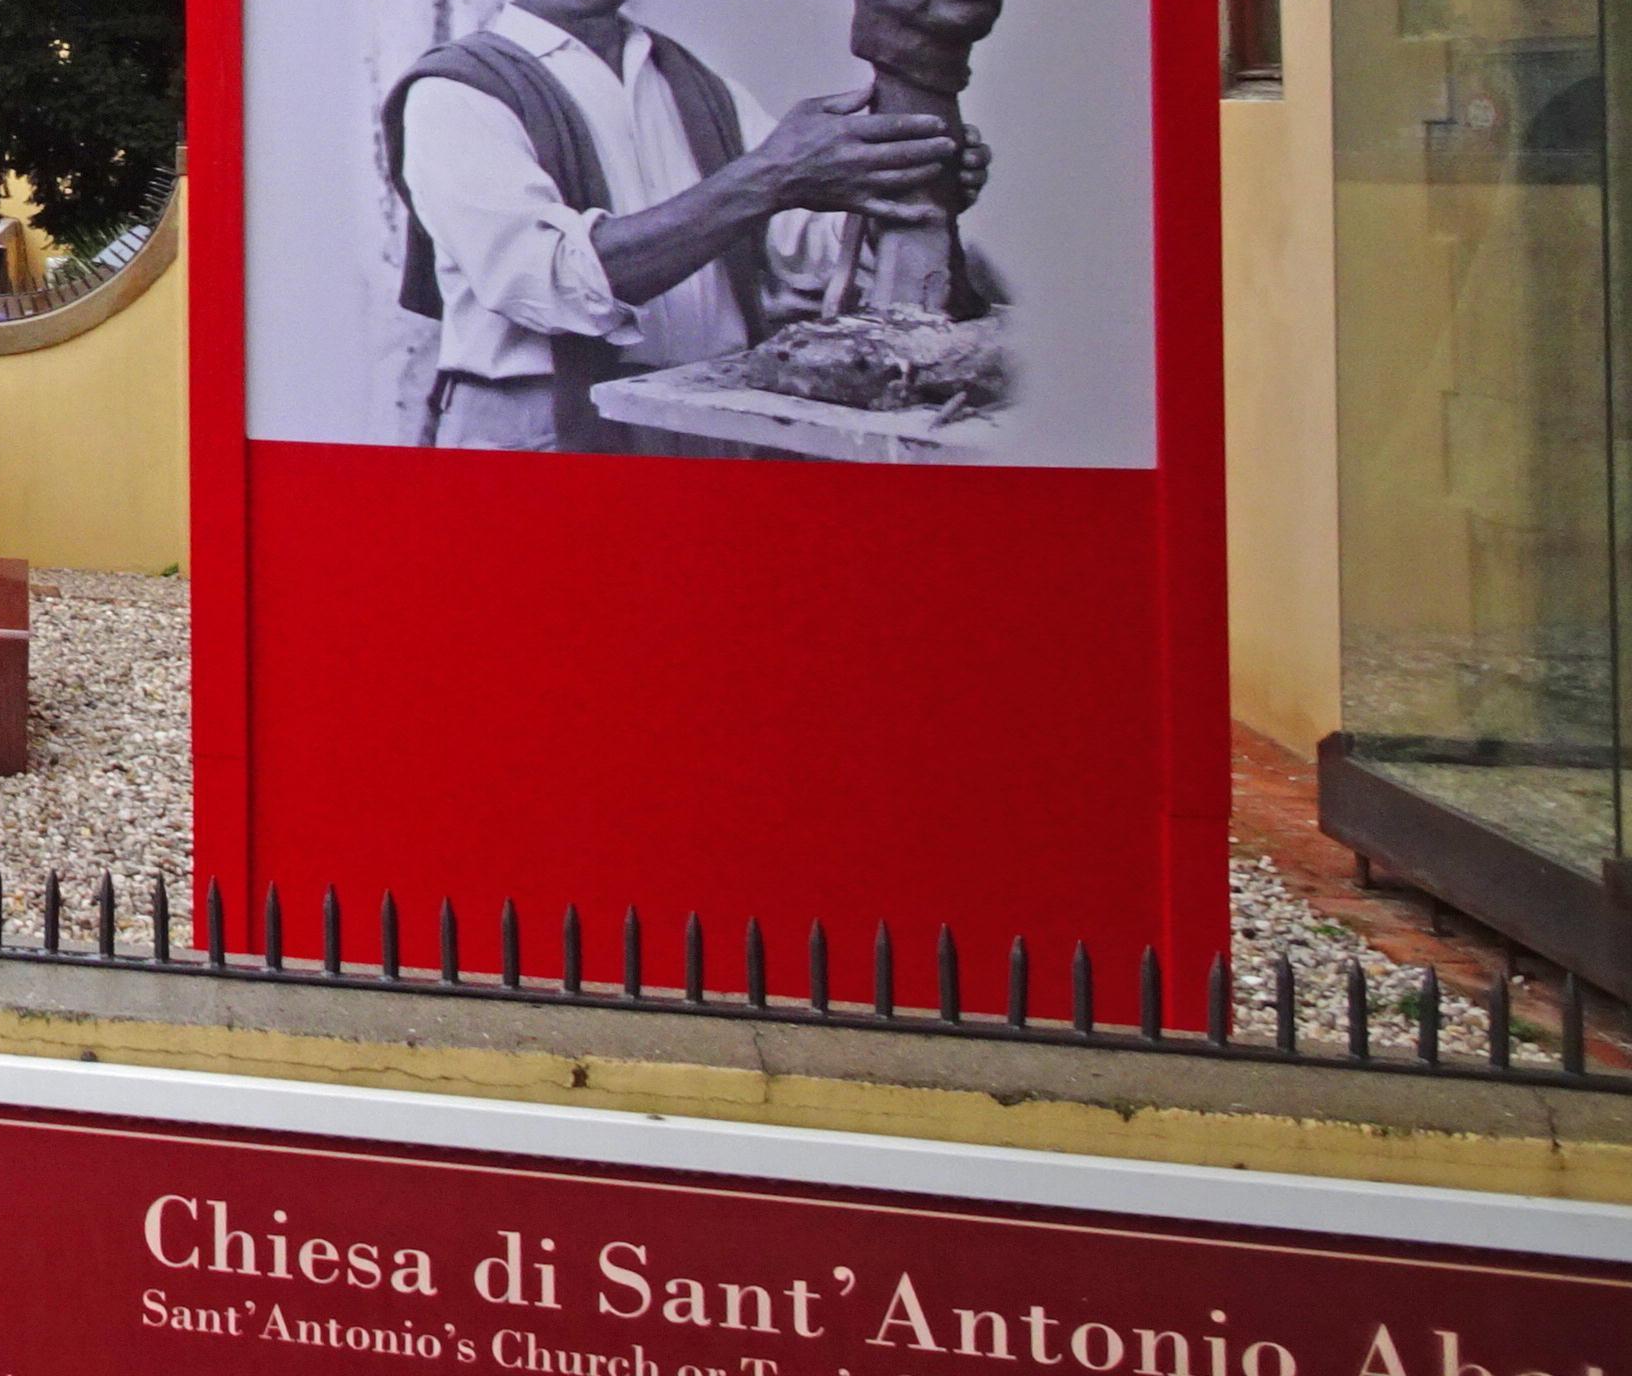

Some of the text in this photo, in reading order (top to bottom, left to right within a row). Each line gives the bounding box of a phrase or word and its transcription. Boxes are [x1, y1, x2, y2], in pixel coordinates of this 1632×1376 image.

[143, 1194, 438, 1296] Chiesa
[473, 1230, 563, 1309] di
[492, 1329, 659, 1376] Church
